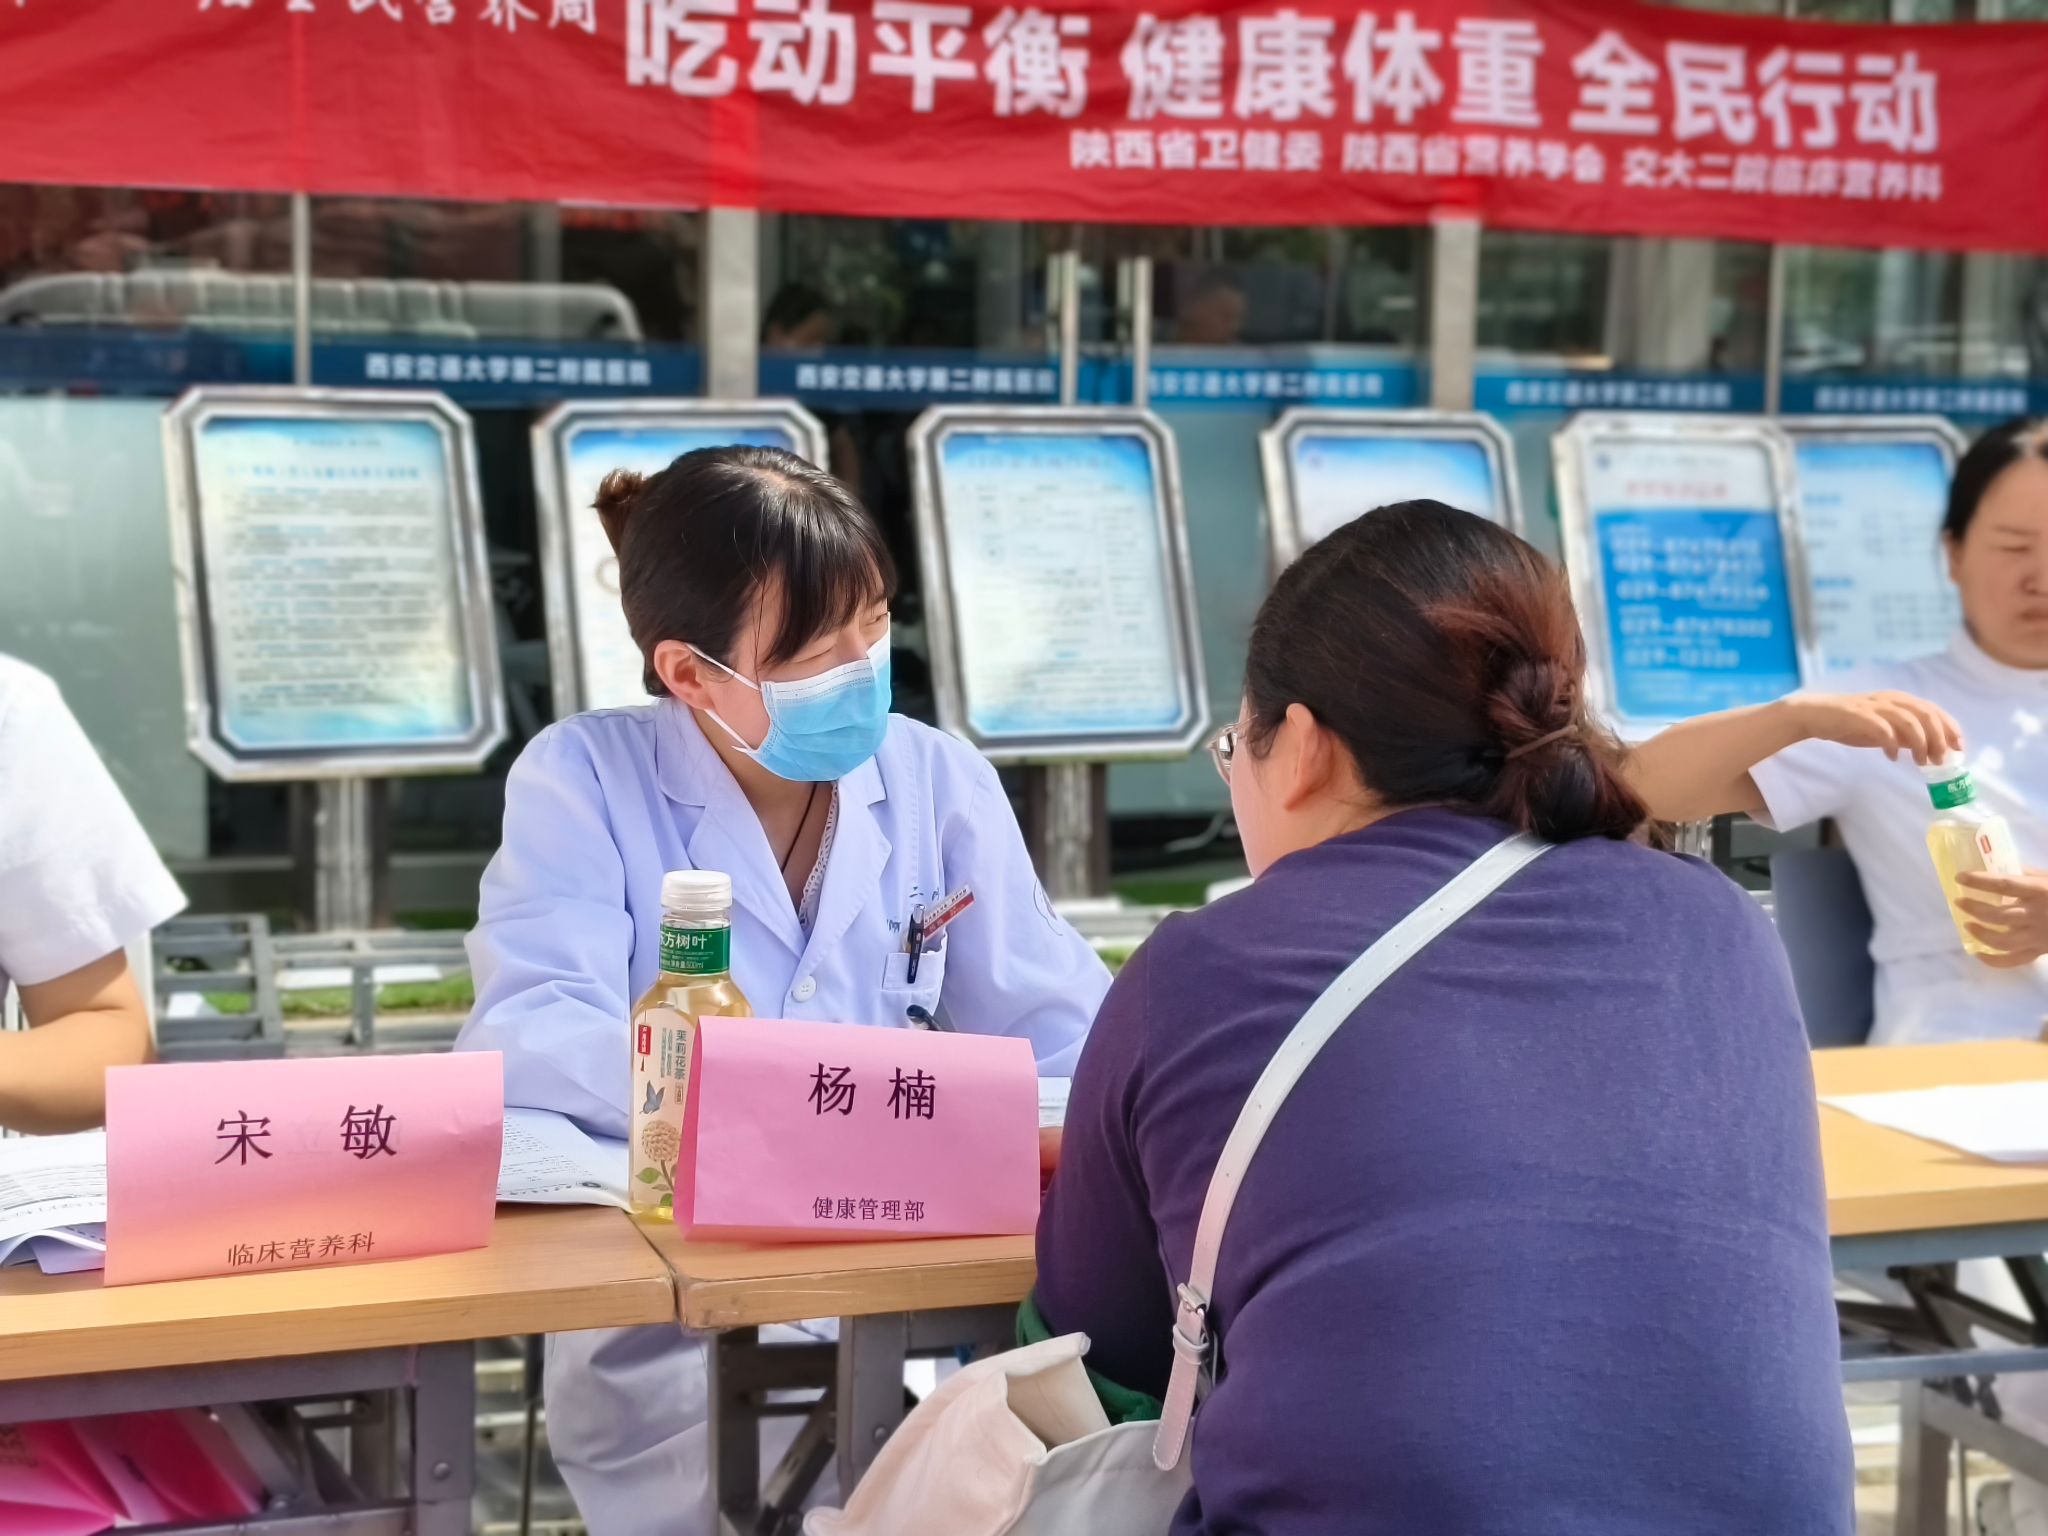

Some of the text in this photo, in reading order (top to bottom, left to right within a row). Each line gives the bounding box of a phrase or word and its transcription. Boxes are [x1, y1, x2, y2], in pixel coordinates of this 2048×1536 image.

[625, 0, 1939, 154] 吃动平衡 健康体重 全民行动
[1070, 129, 1322, 172] 陕西省卫健委
[1341, 132, 1605, 184] 陕西省营养学会
[812, 1196, 925, 1222] 健康管理部
[227, 1231, 375, 1268] 临床营养科
